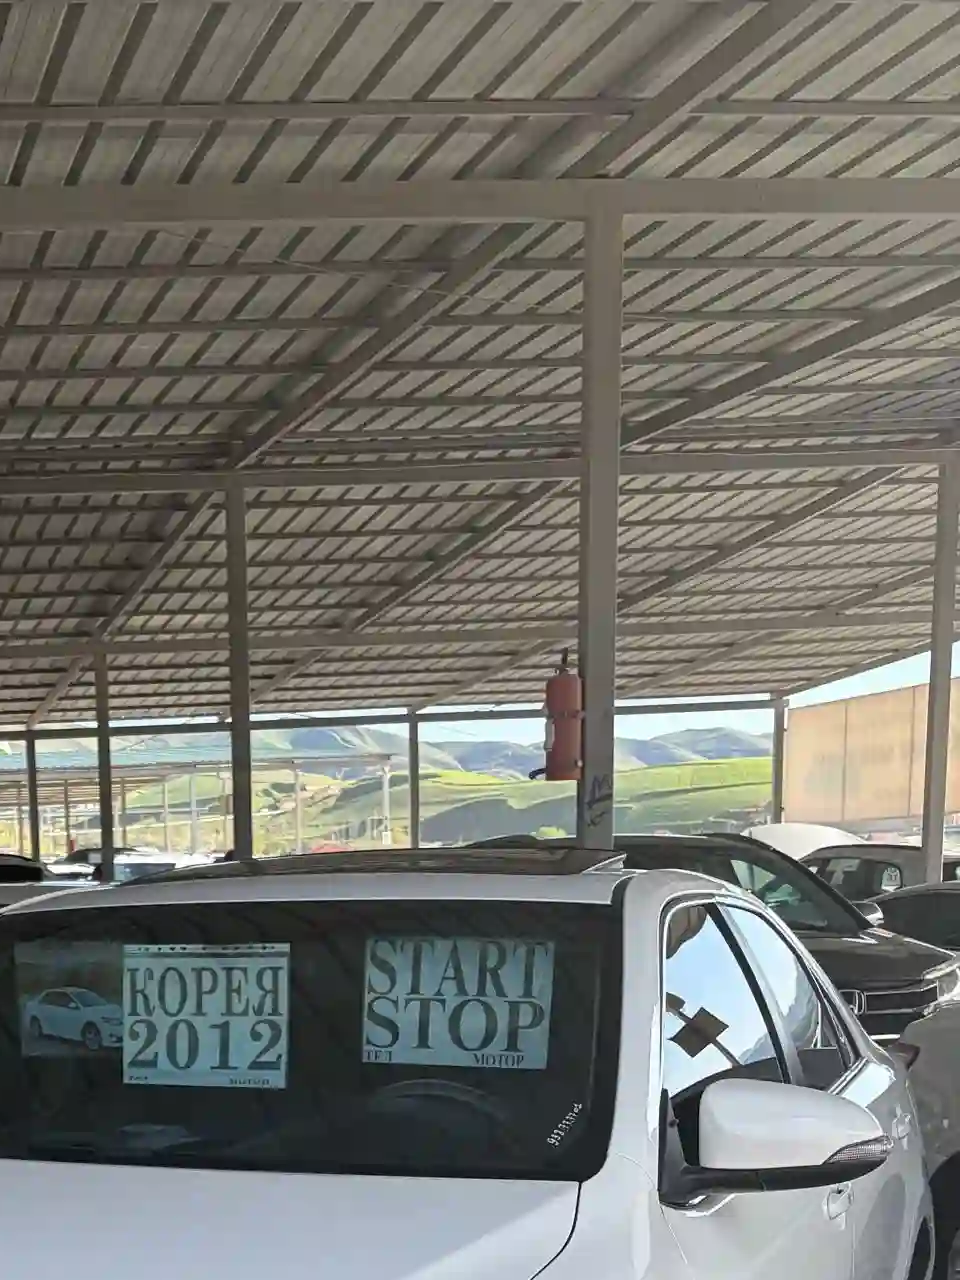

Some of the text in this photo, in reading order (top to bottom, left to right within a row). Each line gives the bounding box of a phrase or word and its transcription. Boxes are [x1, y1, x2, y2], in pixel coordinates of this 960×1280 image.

[126, 966, 285, 1017] КОРЕЯ
[367, 939, 549, 998] START
[127, 1018, 283, 1071] 2012
[366, 995, 546, 1053] STOP
